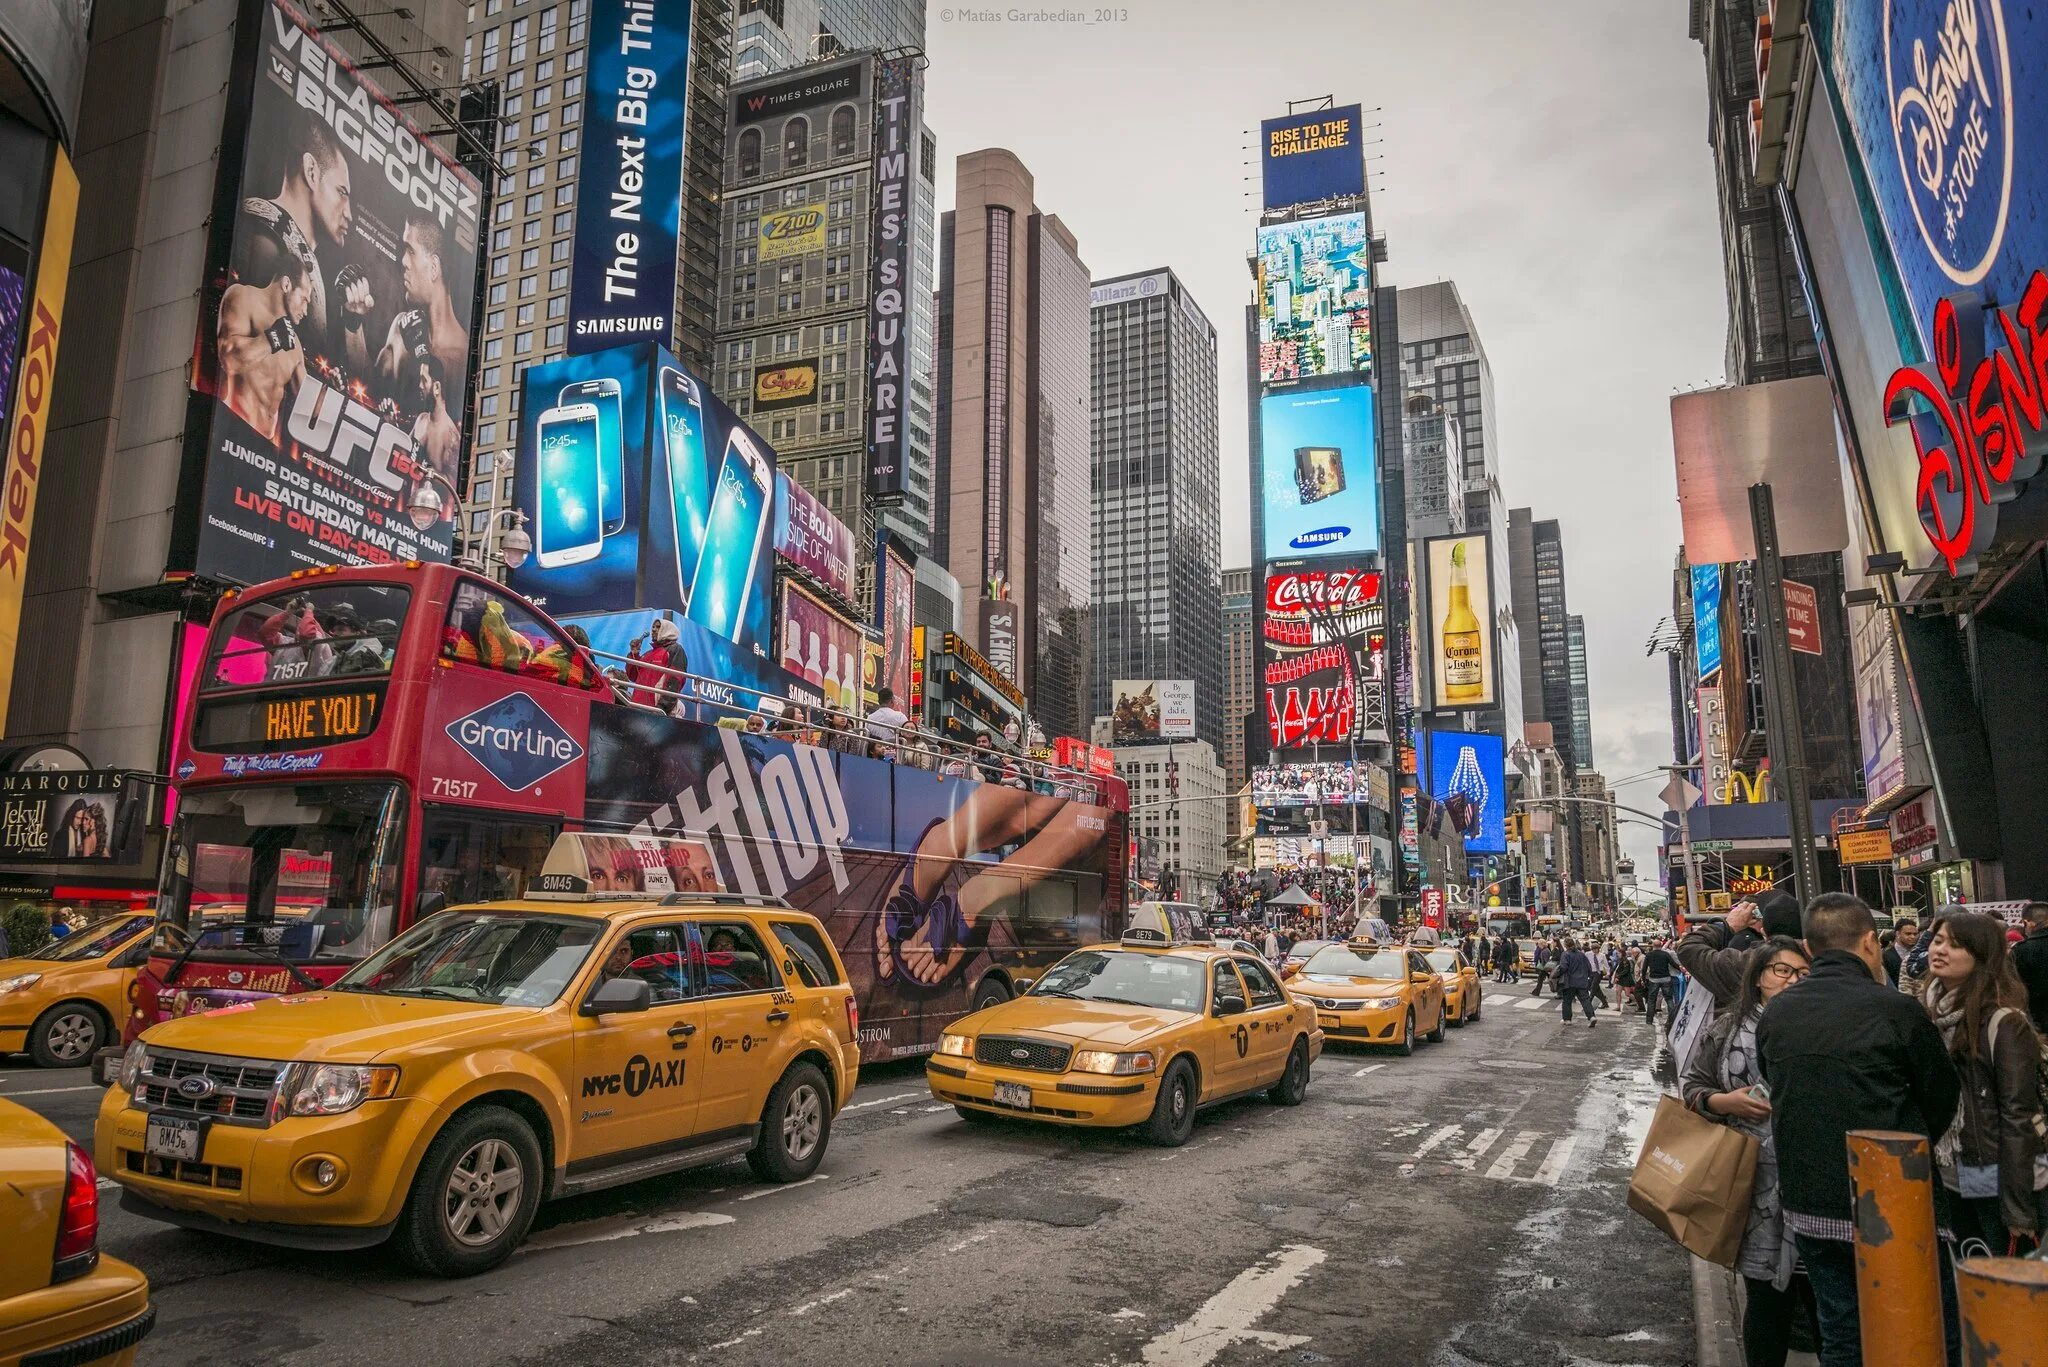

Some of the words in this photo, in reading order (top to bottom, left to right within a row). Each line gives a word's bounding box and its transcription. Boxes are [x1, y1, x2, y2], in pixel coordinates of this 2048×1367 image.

[271, 56, 293, 84] VS
[616, 66, 657, 127] Big
[769, 90, 801, 106] TIMES
[804, 77, 851, 96] SQUARE
[271, 3, 477, 222] VELASQUEZ
[1270, 133, 1349, 158] CHALLENGE.
[1271, 128, 1300, 145] RISE
[1302, 124, 1320, 139] TO
[1322, 118, 1349, 135] THE
[296, 70, 454, 229] BIGFOOT
[1948, 99, 1988, 219] STORE
[610, 136, 646, 222] Next
[879, 96, 906, 240] TIMES
[604, 231, 640, 303] The
[576, 316, 664, 335] SAMSUNG
[874, 258, 903, 444] SQUARE
[0, 297, 58, 583] Kodak
[287, 373, 414, 492] UFC
[543, 434, 570, 449] 12:45
[302, 451, 344, 478] PRESENTED
[343, 471, 355, 483] BY
[873, 465, 894, 475] NYC
[221, 439, 276, 475] JUNIOR
[279, 466, 310, 490] DOS
[312, 482, 365, 517] SANTOS
[366, 507, 383, 526] VS
[385, 518, 418, 542] MARK
[420, 534, 449, 556] HUNT
[234, 486, 282, 523] LIVE
[286, 511, 315, 536] ON
[208, 514, 267, 546] facebook.com/UFC
[264, 479, 361, 537] SATURDAY
[362, 524, 397, 552] MAY
[397, 542, 418, 560] 25
[788, 493, 808, 526] THE
[809, 510, 833, 545] BOLD
[786, 520, 809, 553] SIDE
[810, 538, 823, 561] OF
[823, 546, 849, 584] WATER
[1297, 532, 1344, 543] SAMSUNG
[290, 549, 315, 564] TICKETS
[1445, 647, 1480, 660] Corona
[1453, 660, 1473, 670] Light
[273, 661, 308, 680] 71517
[1173, 683, 1182, 693] By
[267, 701, 315, 741] HAVE
[322, 696, 360, 736] YOU
[1167, 706, 1180, 714] did
[460, 719, 523, 752] Gray
[526, 728, 573, 760] Line
[3, 774, 122, 791] MARQUIS
[432, 777, 478, 799] 71517
[1, 800, 47, 829] Jekyll
[629, 727, 849, 908] tflop
[5, 823, 49, 854] Hyde
[640, 841, 655, 849] THE
[612, 848, 691, 871] INTERNSHIP
[543, 876, 572, 890] 8M45
[648, 876, 663, 884] JUNE
[1427, 891, 1441, 917] tkts
[1136, 930, 1152, 940] 8E79
[771, 992, 795, 1006] 8M45
[582, 1074, 621, 1098] NYC
[626, 1057, 685, 1095] TAXI
